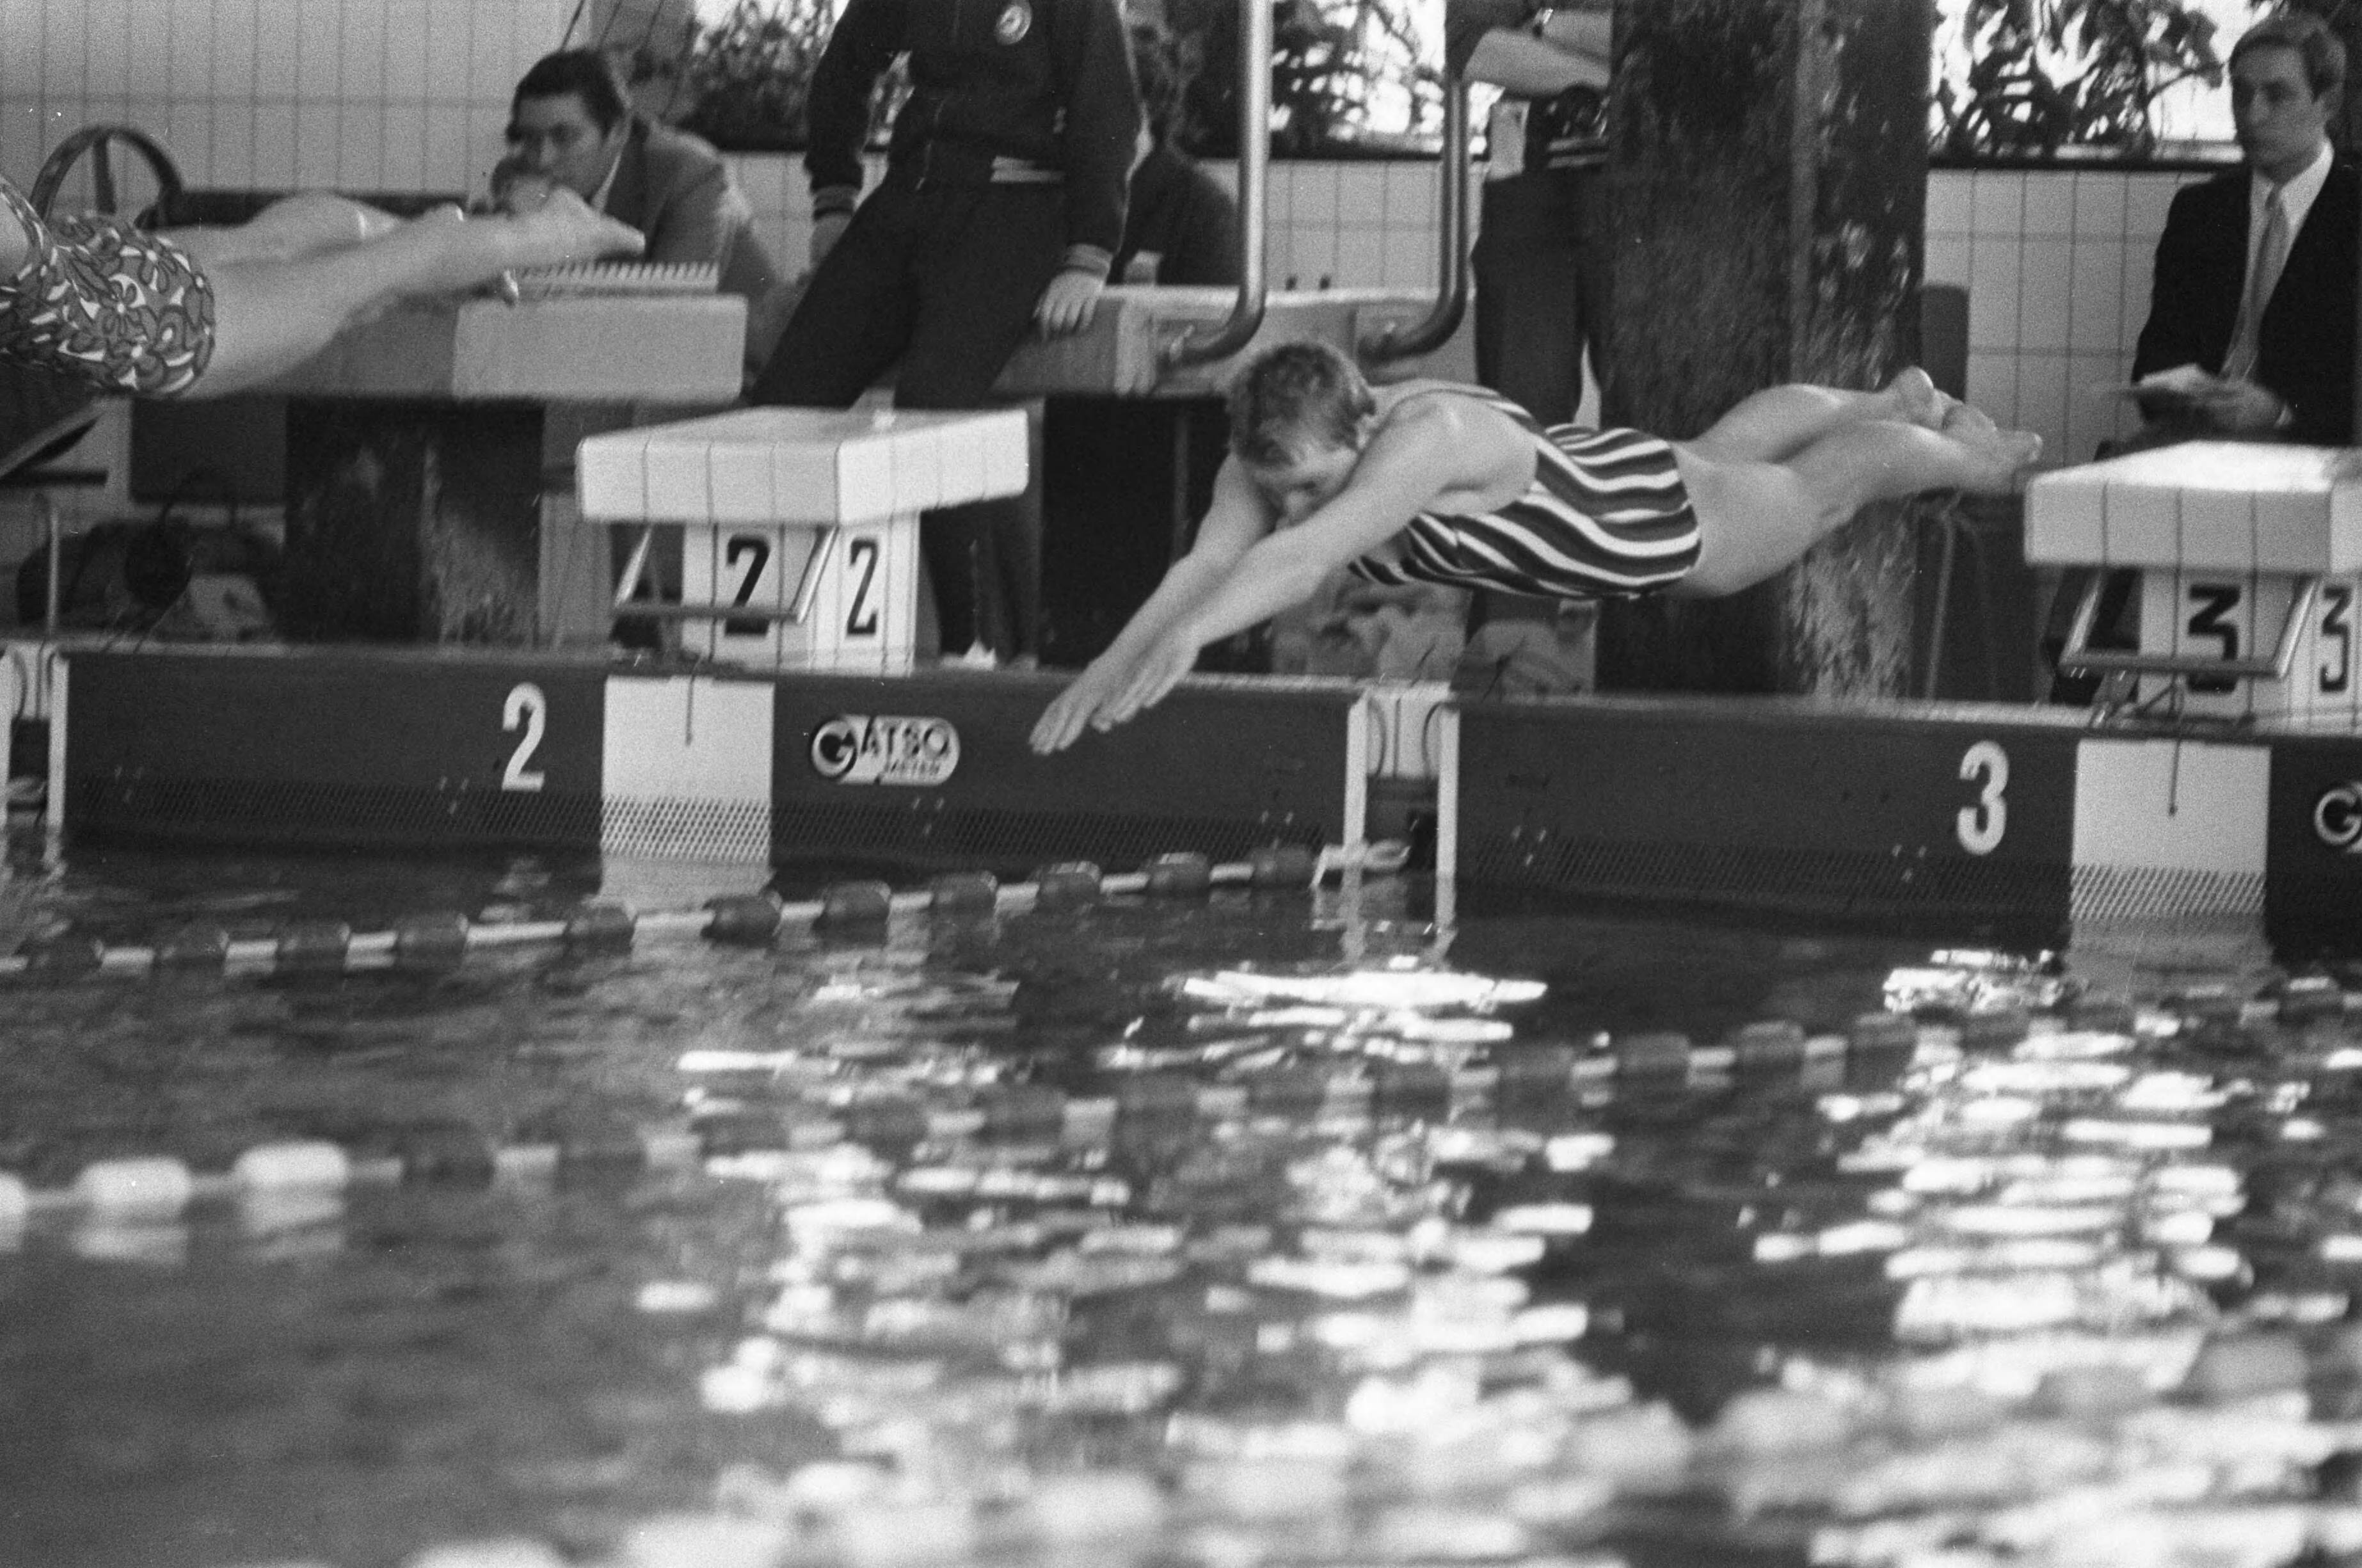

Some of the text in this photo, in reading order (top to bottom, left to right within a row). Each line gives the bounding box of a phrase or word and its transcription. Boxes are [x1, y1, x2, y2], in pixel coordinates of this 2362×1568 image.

[726, 536, 770, 636] 2
[847, 538, 877, 636] 2
[2185, 585, 2240, 692] 3
[2320, 586, 2352, 692] 3
[502, 682, 545, 790] 2
[810, 716, 950, 778] GATSO
[1958, 740, 2008, 854] 3
